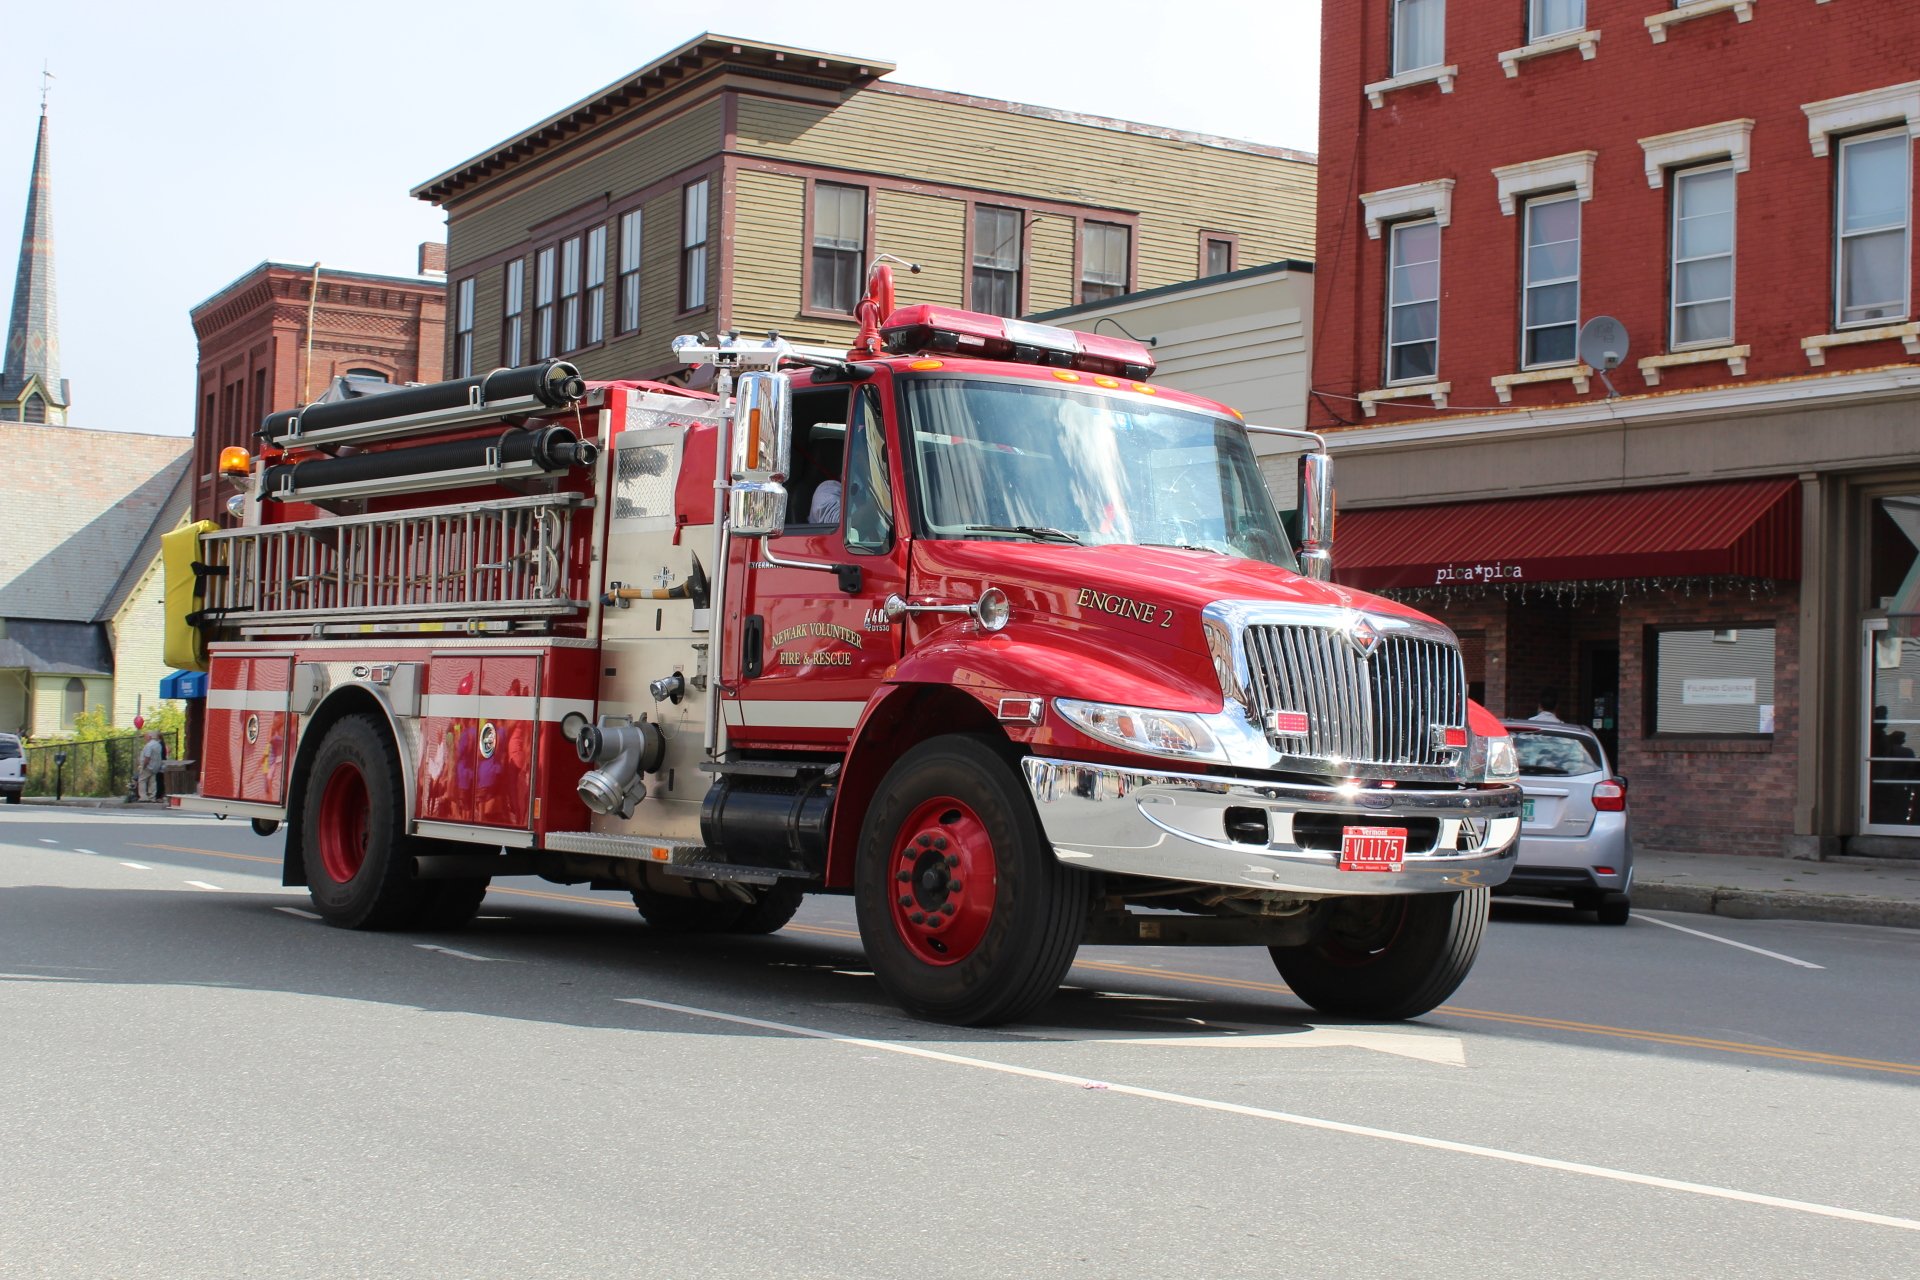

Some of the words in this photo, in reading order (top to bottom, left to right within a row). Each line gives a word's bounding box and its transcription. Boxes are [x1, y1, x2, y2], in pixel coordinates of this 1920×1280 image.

[1076, 587, 1157, 623] ENGINE
[1160, 609, 1174, 628] 2
[772, 624, 807, 649] NEWARK
[809, 622, 862, 649] VOLUNTEER
[780, 652, 800, 665] FIRE
[803, 653, 810, 665] &
[812, 652, 851, 665] RESCUE
[1354, 839, 1399, 861] VL1175
